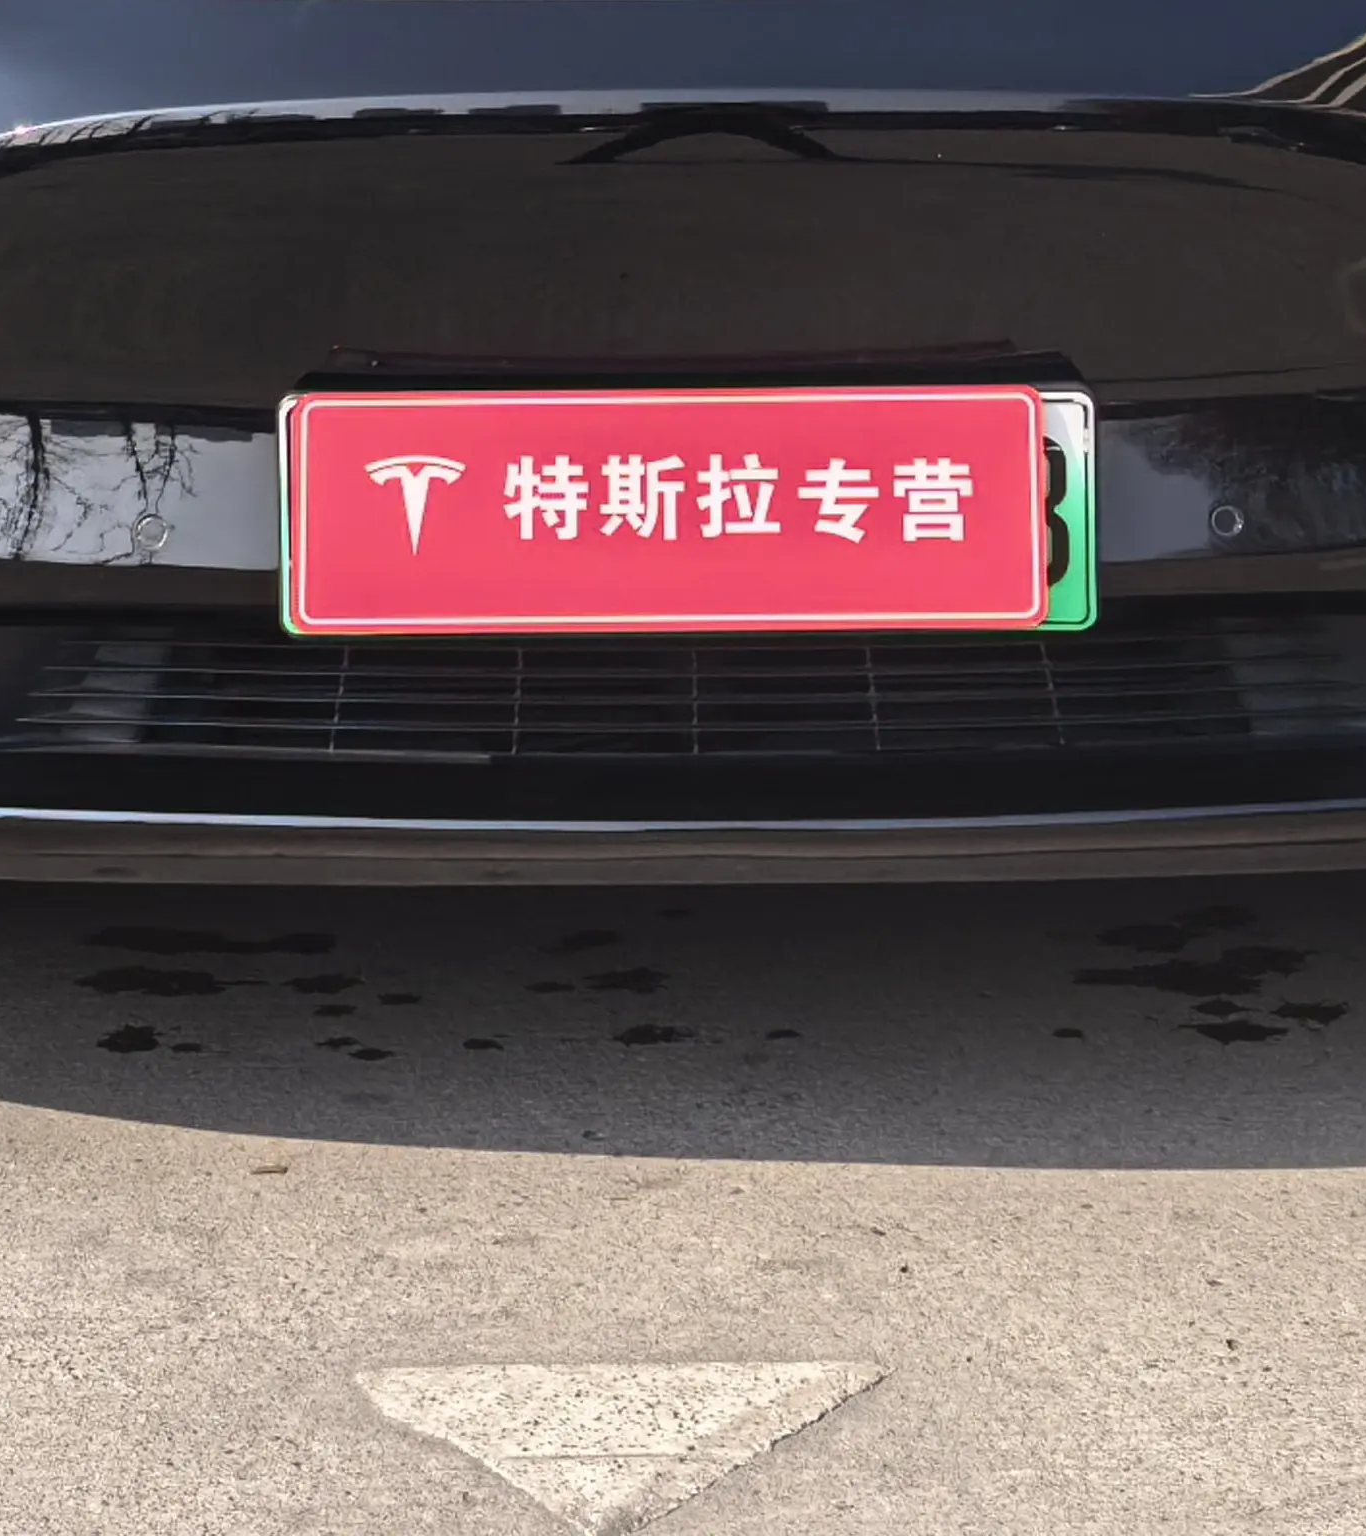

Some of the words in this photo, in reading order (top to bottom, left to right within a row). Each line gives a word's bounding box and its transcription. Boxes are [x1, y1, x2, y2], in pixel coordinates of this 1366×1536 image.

[503, 454, 974, 544] 特斯拉专营
